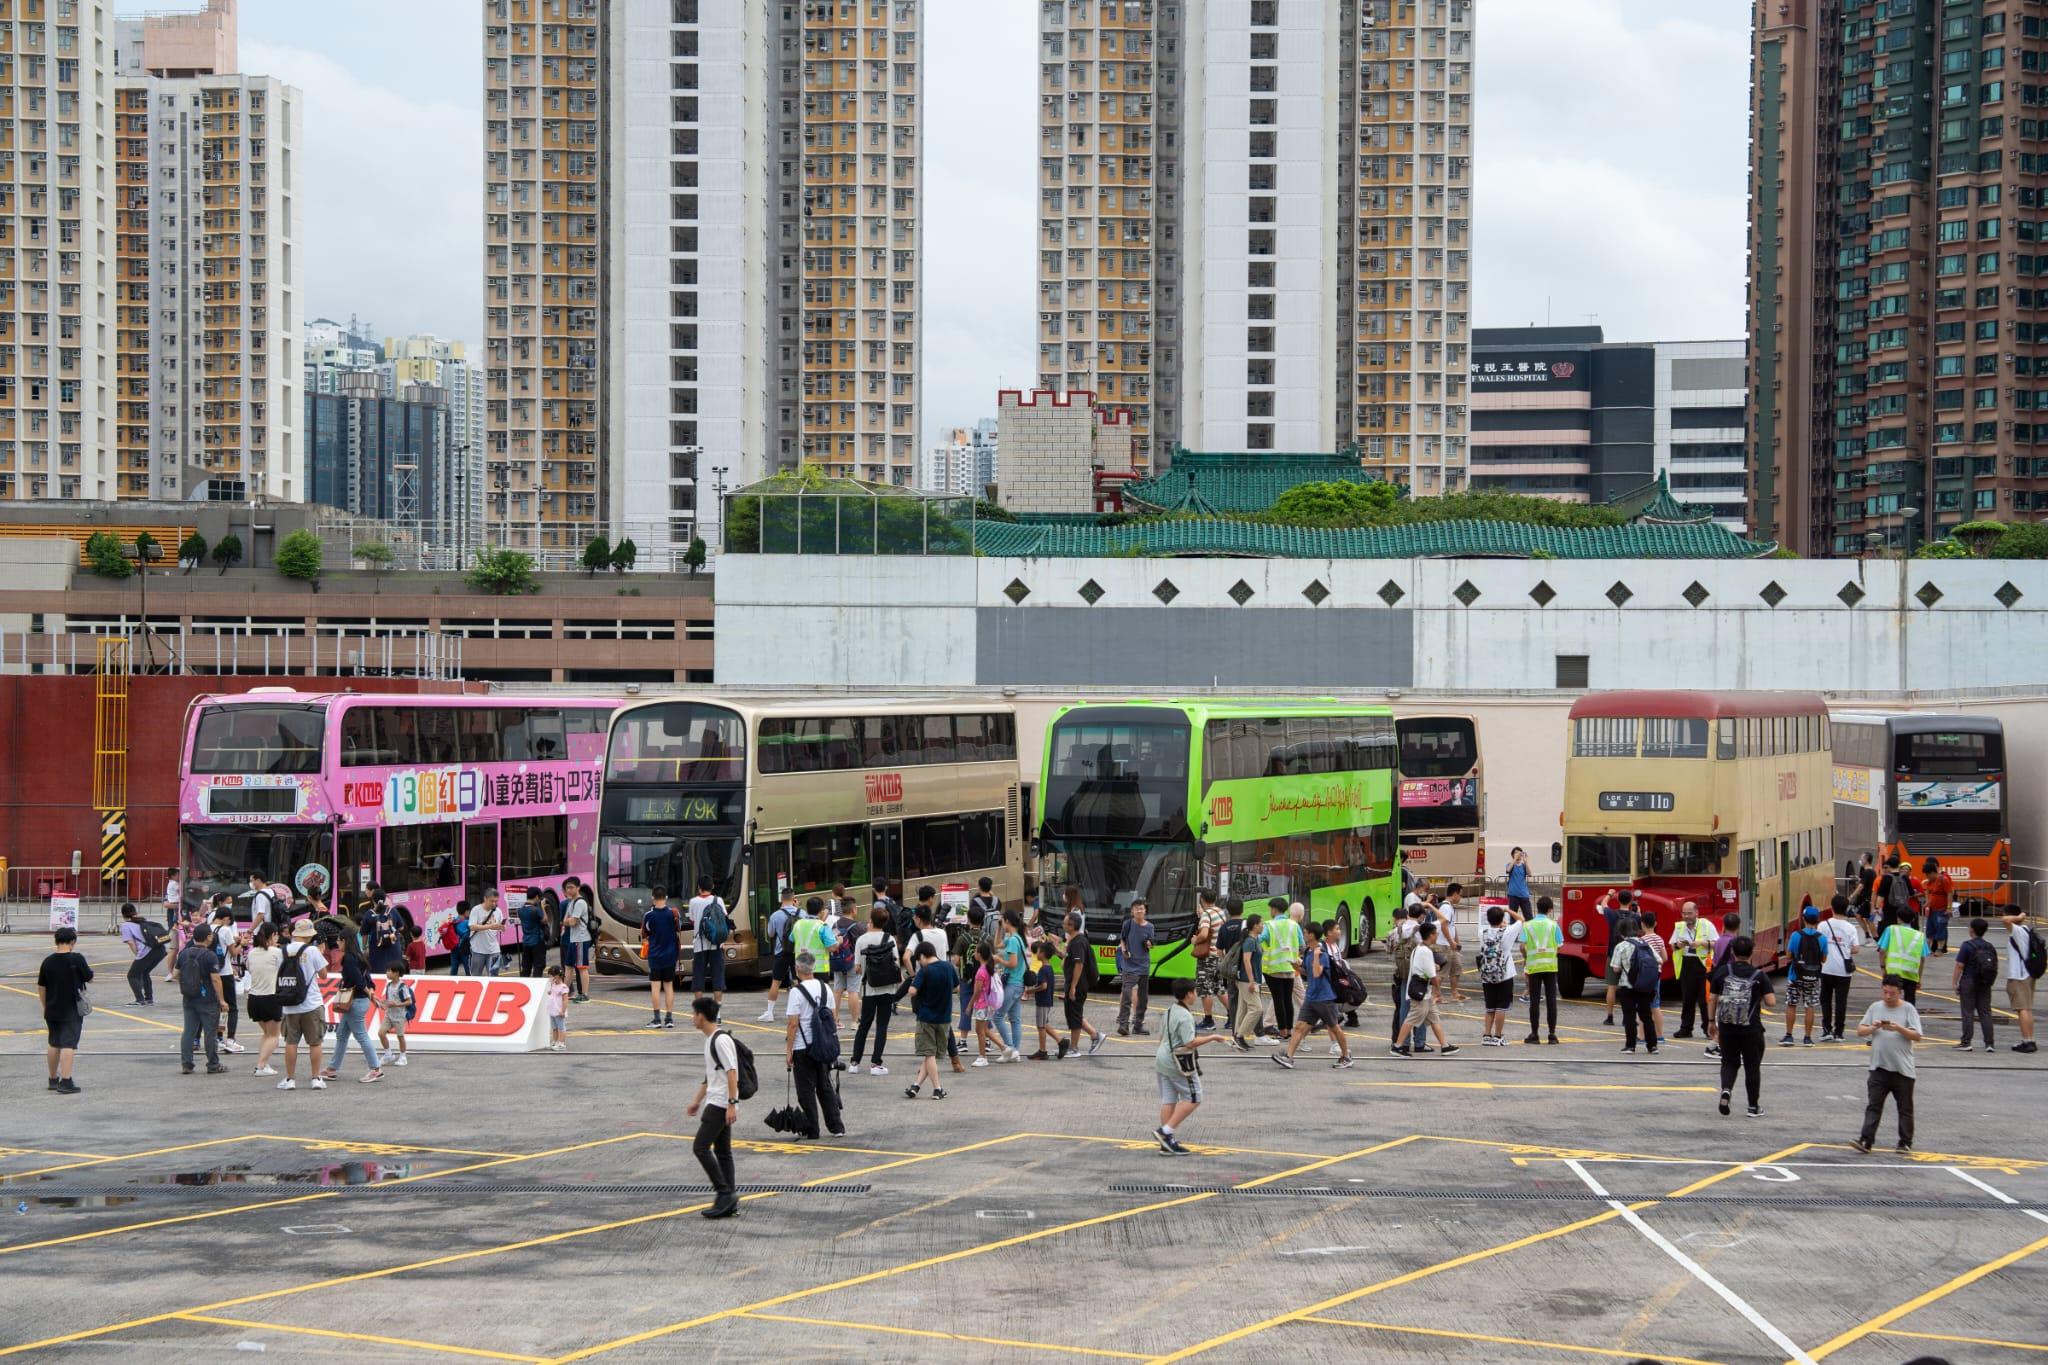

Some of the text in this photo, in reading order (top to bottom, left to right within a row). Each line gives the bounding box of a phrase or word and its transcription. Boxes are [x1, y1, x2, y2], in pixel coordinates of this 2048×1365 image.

[1478, 374, 1506, 382] WALES
[1507, 374, 1547, 382] HOSPITAL
[221, 775, 243, 786] KMB
[875, 773, 903, 803] KMB
[1429, 783, 1449, 793] DICK
[355, 782, 383, 808] KMB
[391, 771, 476, 816] 13個紅日
[683, 798, 717, 820] 79K
[1650, 794, 1670, 809] 11D
[1212, 796, 1233, 827] KMB
[1099, 946, 1117, 958] KM
[278, 976, 298, 987] VAN
[364, 978, 532, 1037] KMB
